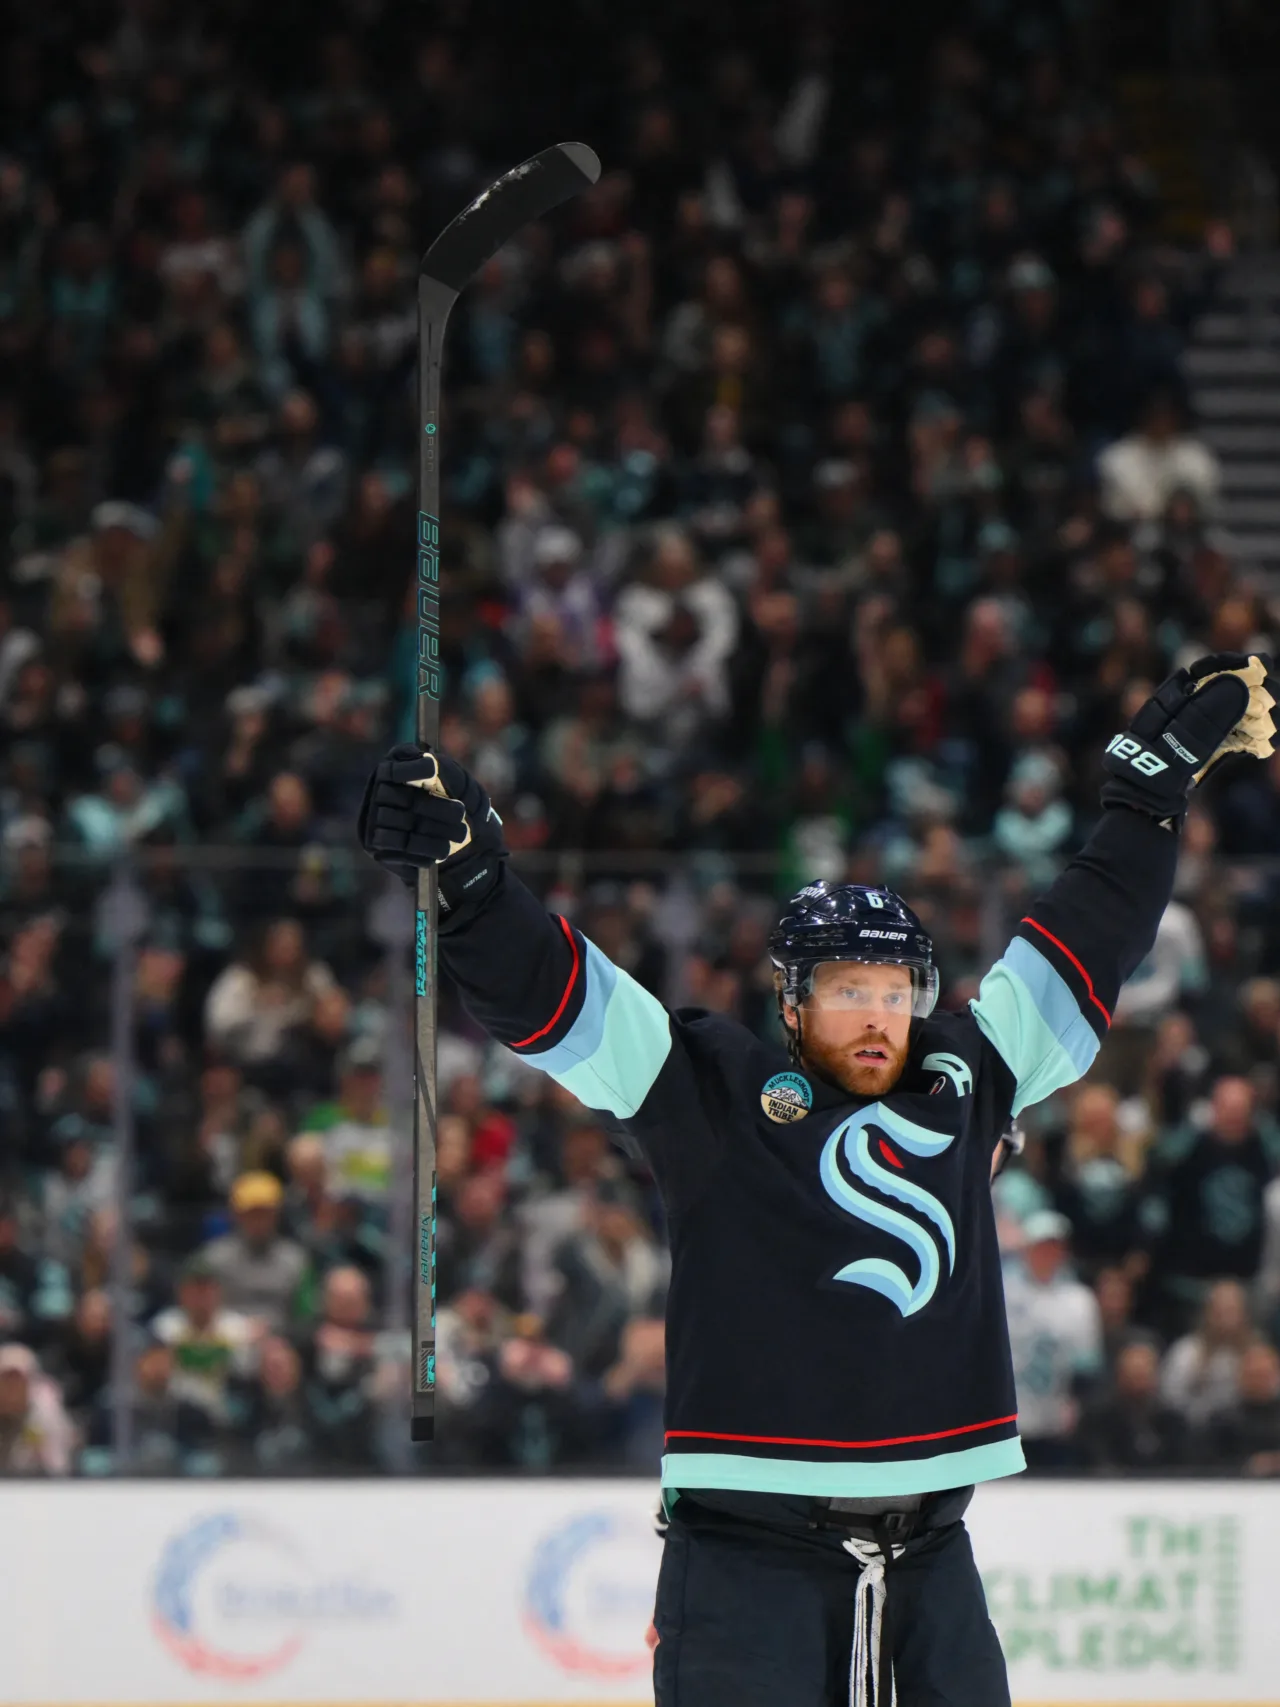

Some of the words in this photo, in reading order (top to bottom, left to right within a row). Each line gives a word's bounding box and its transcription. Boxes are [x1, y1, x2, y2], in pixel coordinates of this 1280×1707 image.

[417, 510, 440, 701] BAUER
[865, 892, 884, 908] 6
[859, 929, 908, 941] BAUER
[416, 912, 425, 992] TWITCH
[768, 1074, 810, 1102] MUCKLESHOOT
[768, 1099, 799, 1116] INDIAN
[768, 1107, 794, 1123] TRIBE
[420, 1228, 429, 1285] BAUER
